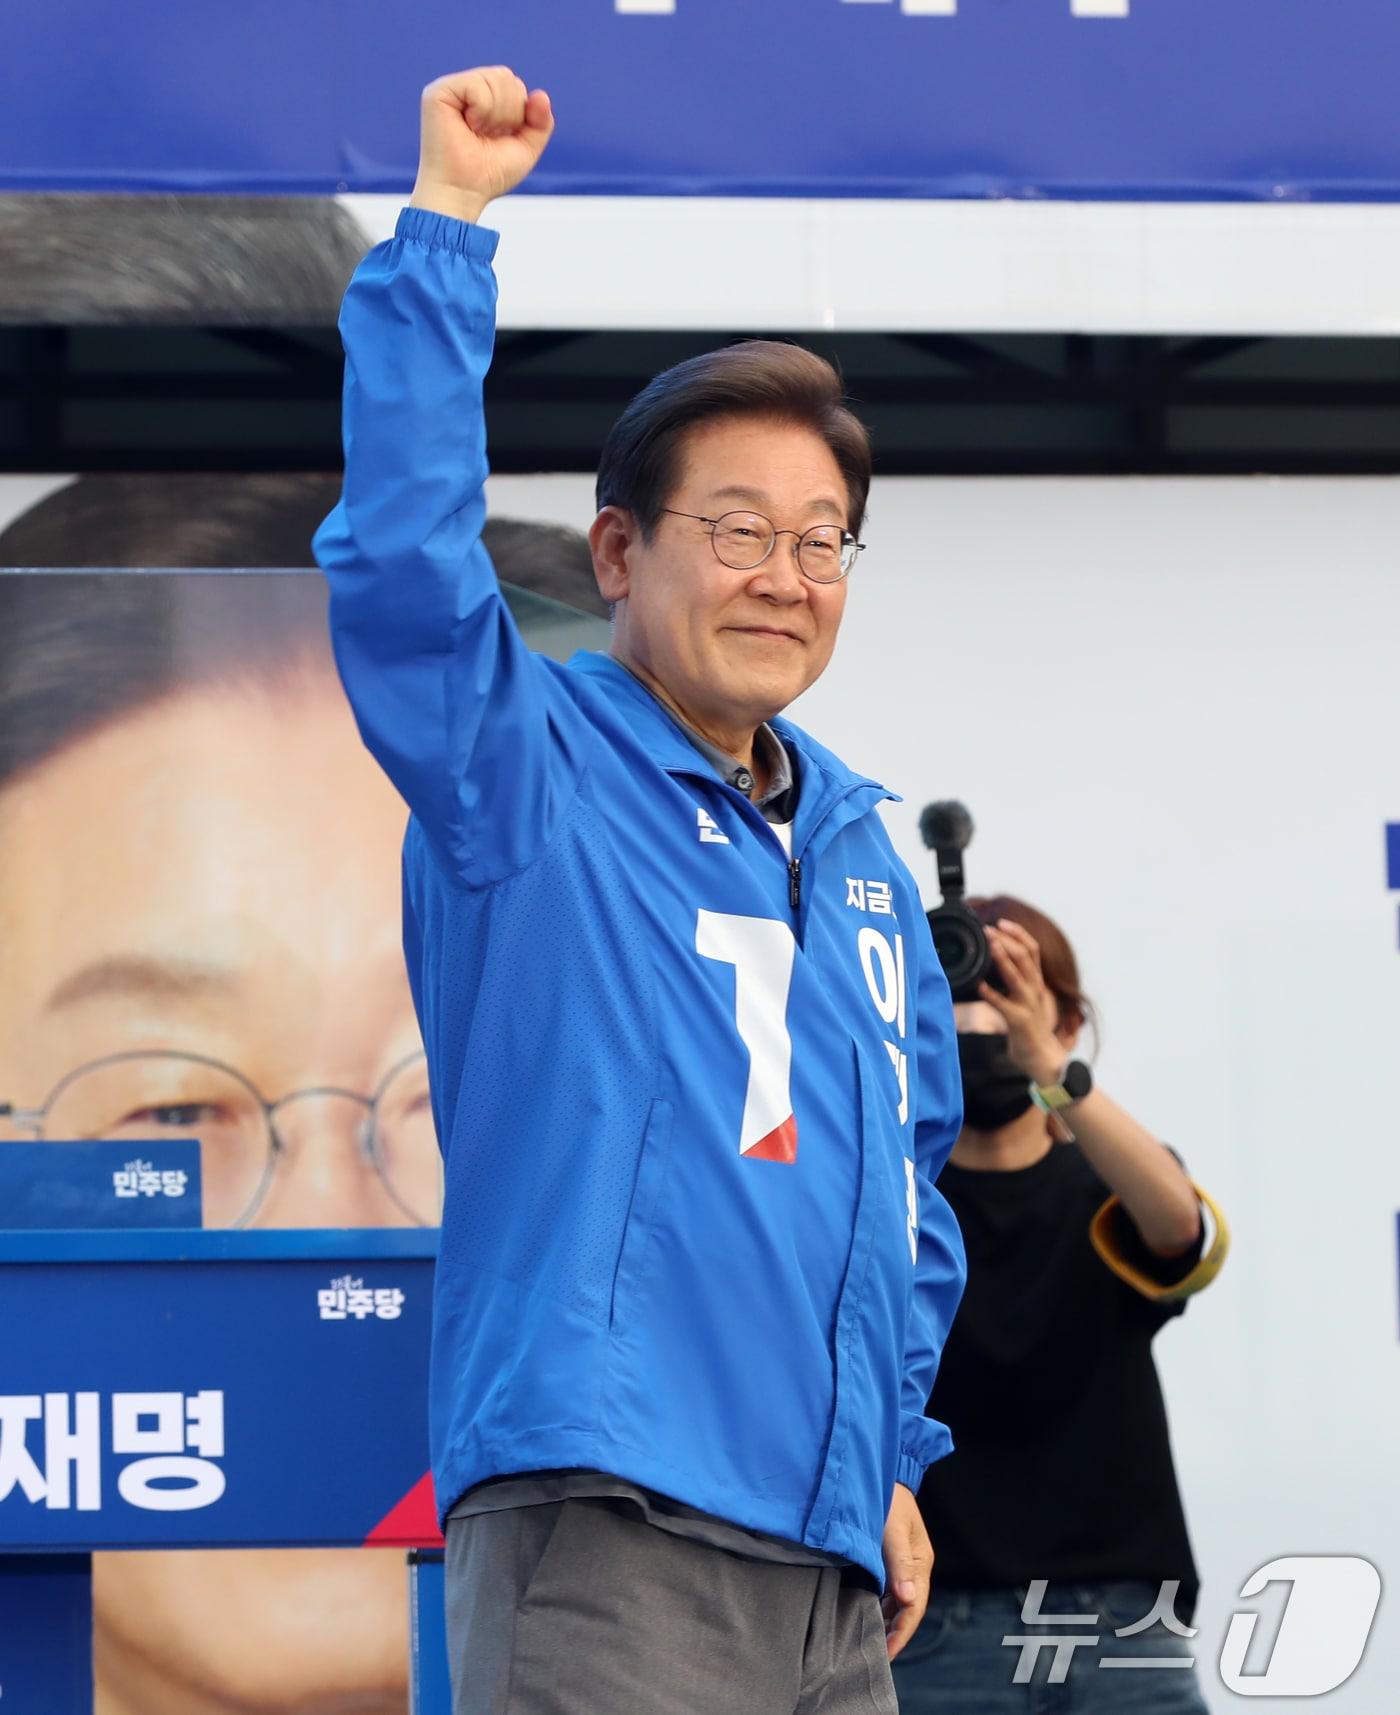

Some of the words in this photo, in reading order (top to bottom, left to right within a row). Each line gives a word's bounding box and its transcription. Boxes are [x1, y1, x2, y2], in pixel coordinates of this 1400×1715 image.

[845, 877, 898, 920] 지금
[113, 1169, 188, 1198] 민주당
[317, 1287, 405, 1320] 민주당
[0, 1390, 227, 1511] 재명
